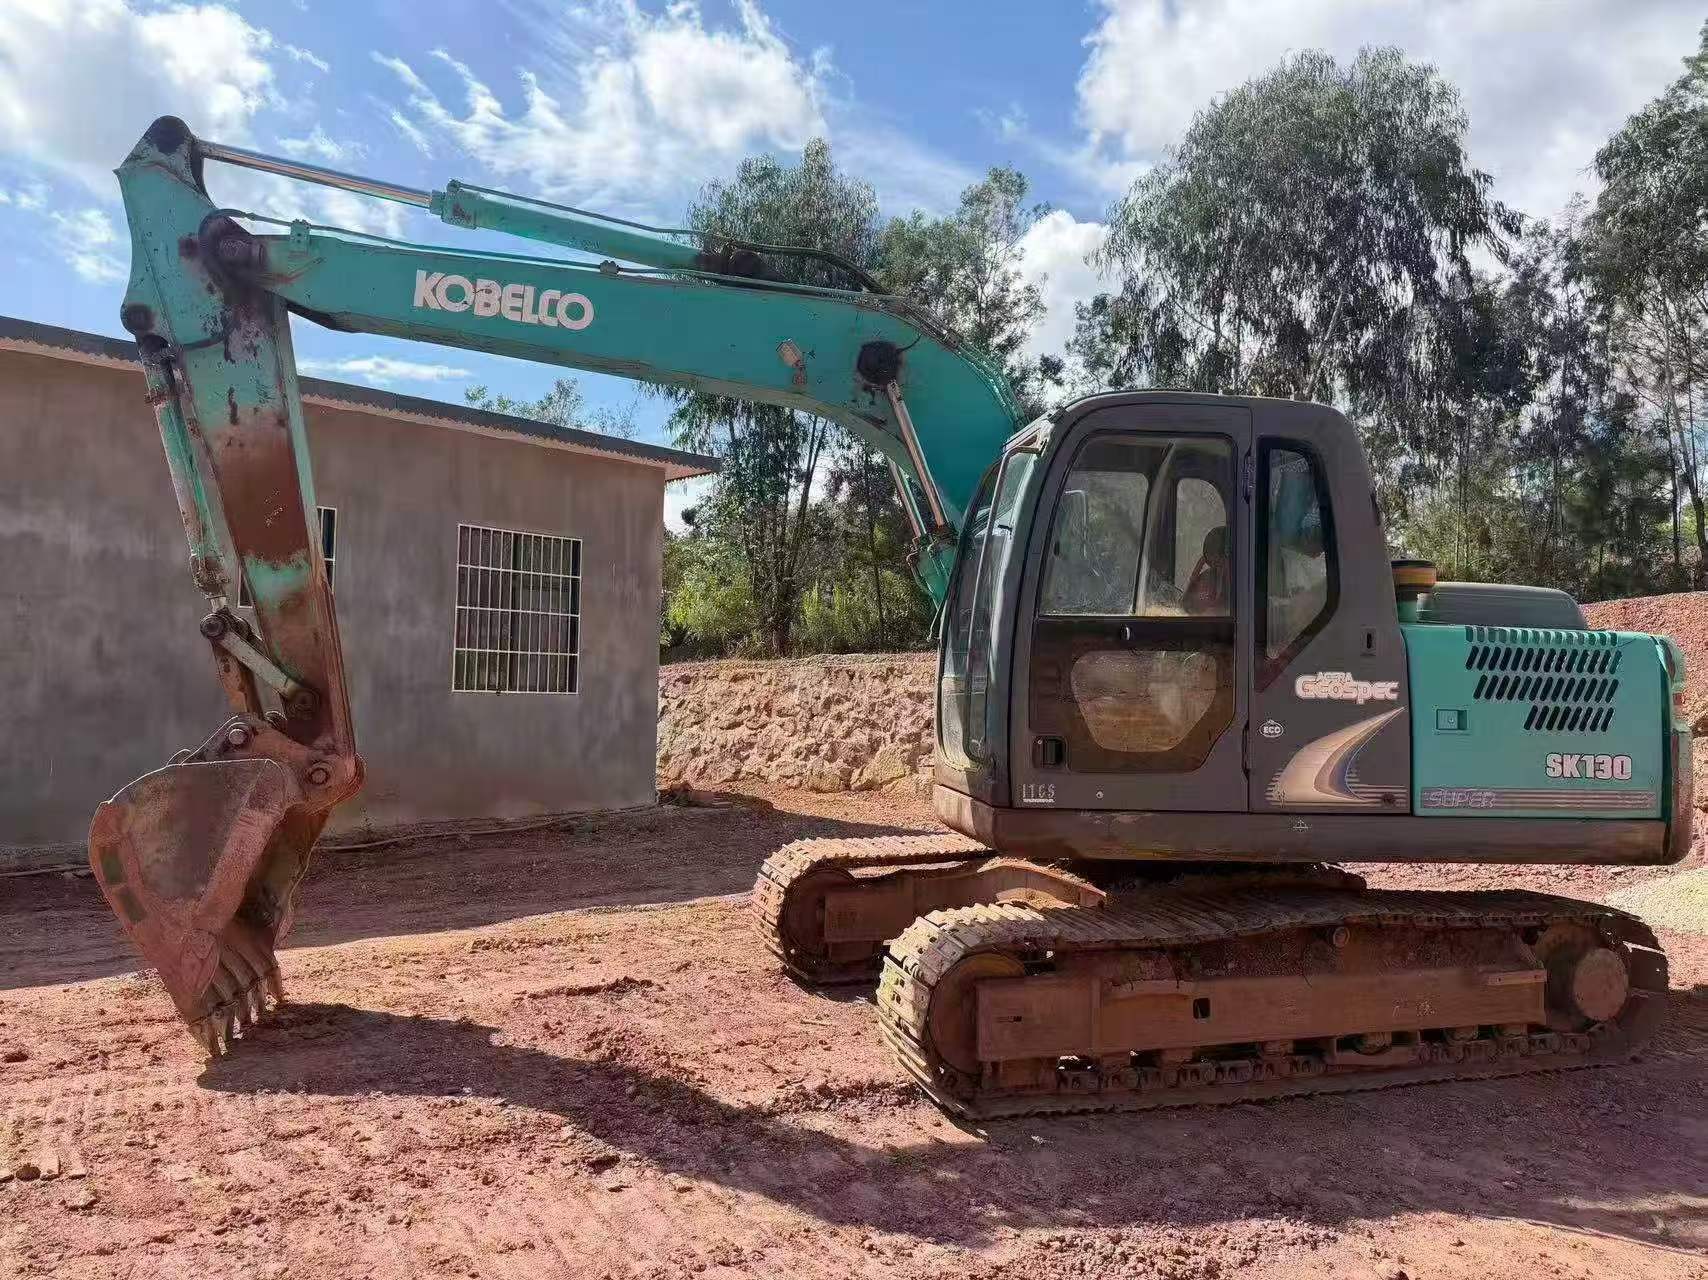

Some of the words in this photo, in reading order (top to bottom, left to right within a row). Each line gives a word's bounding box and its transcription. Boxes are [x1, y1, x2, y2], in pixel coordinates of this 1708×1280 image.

[413, 269, 595, 331] KOBELCO
[1263, 726, 1281, 734] ECO
[1545, 752, 1632, 780] SK130
